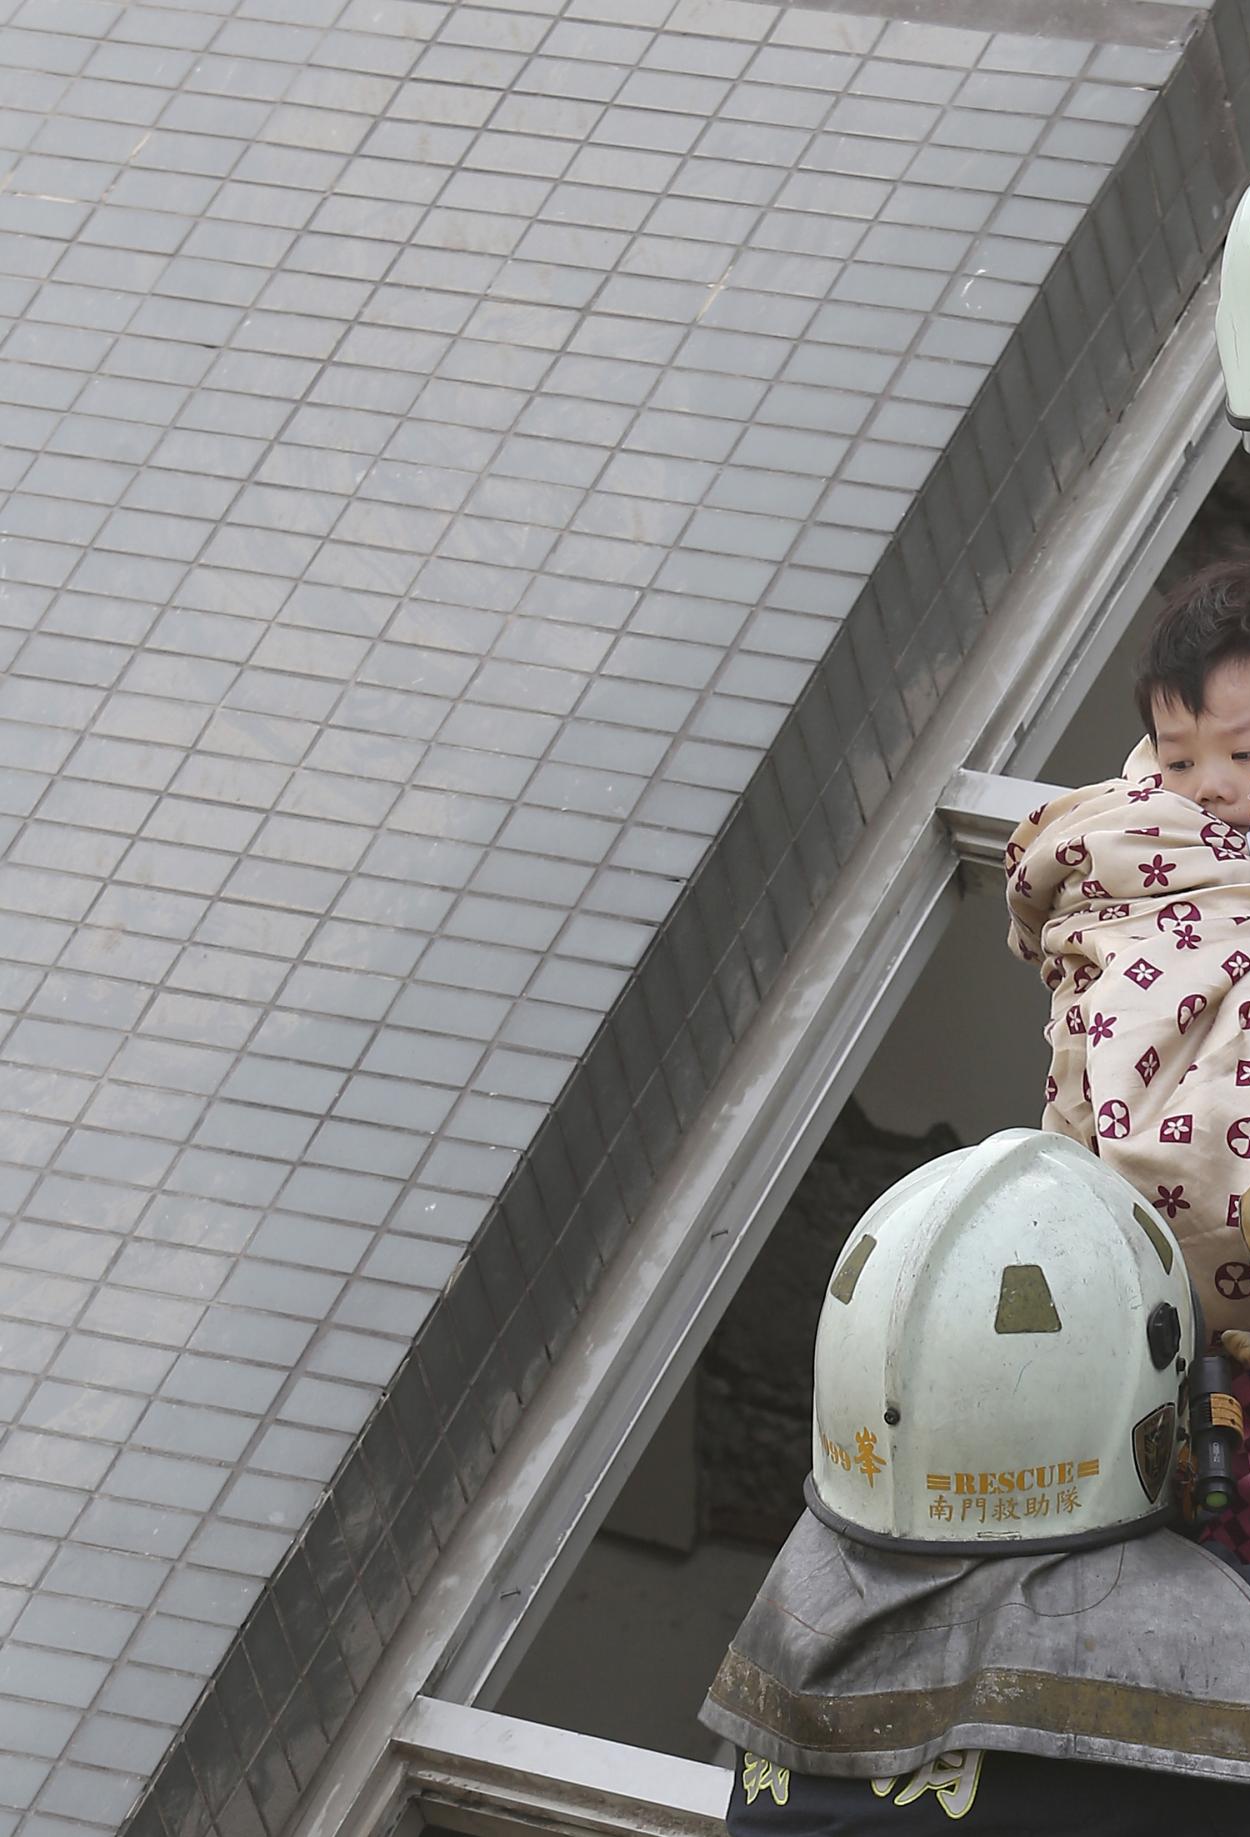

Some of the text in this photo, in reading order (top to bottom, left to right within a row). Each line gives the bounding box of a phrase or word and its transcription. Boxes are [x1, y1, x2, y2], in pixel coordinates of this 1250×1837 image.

[954, 1461, 1074, 1495] RESCUE
[929, 1486, 1083, 1524] 南門救助隊
